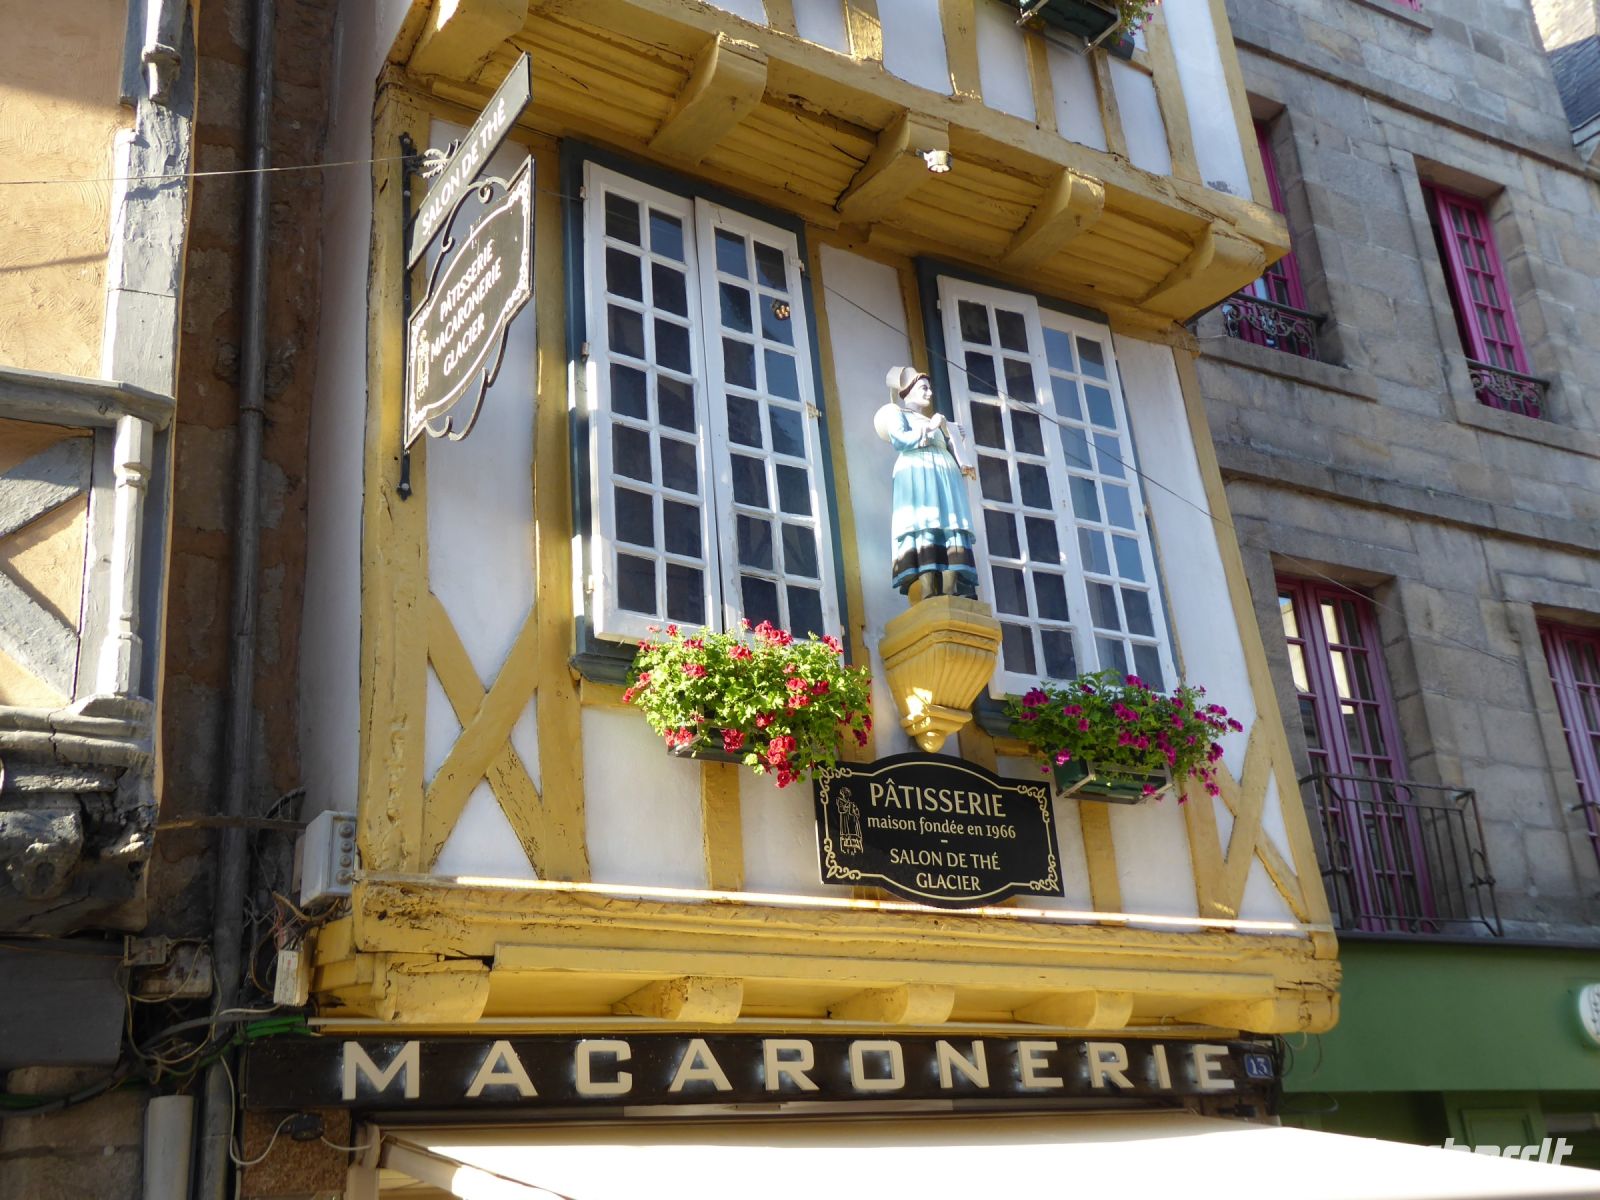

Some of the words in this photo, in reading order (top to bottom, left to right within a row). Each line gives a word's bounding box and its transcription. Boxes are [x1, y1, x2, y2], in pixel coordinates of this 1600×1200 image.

[422, 167, 460, 235] SALON
[462, 141, 479, 179] DE
[430, 256, 502, 362] MACARONERIE
[443, 312, 485, 376] GLACIER
[869, 778, 1007, 818] PÂTISSERIE
[867, 815, 917, 832] maison
[919, 816, 964, 835] fondée
[967, 824, 983, 837] en
[986, 824, 1017, 839] 1966
[890, 848, 943, 867] SALON
[946, 852, 968, 868] DE
[970, 852, 1001, 870] THÉ
[916, 872, 981, 892] GLACIER
[342, 1038, 1237, 1101] MACARONERIE
[1250, 1057, 1268, 1076] 13
